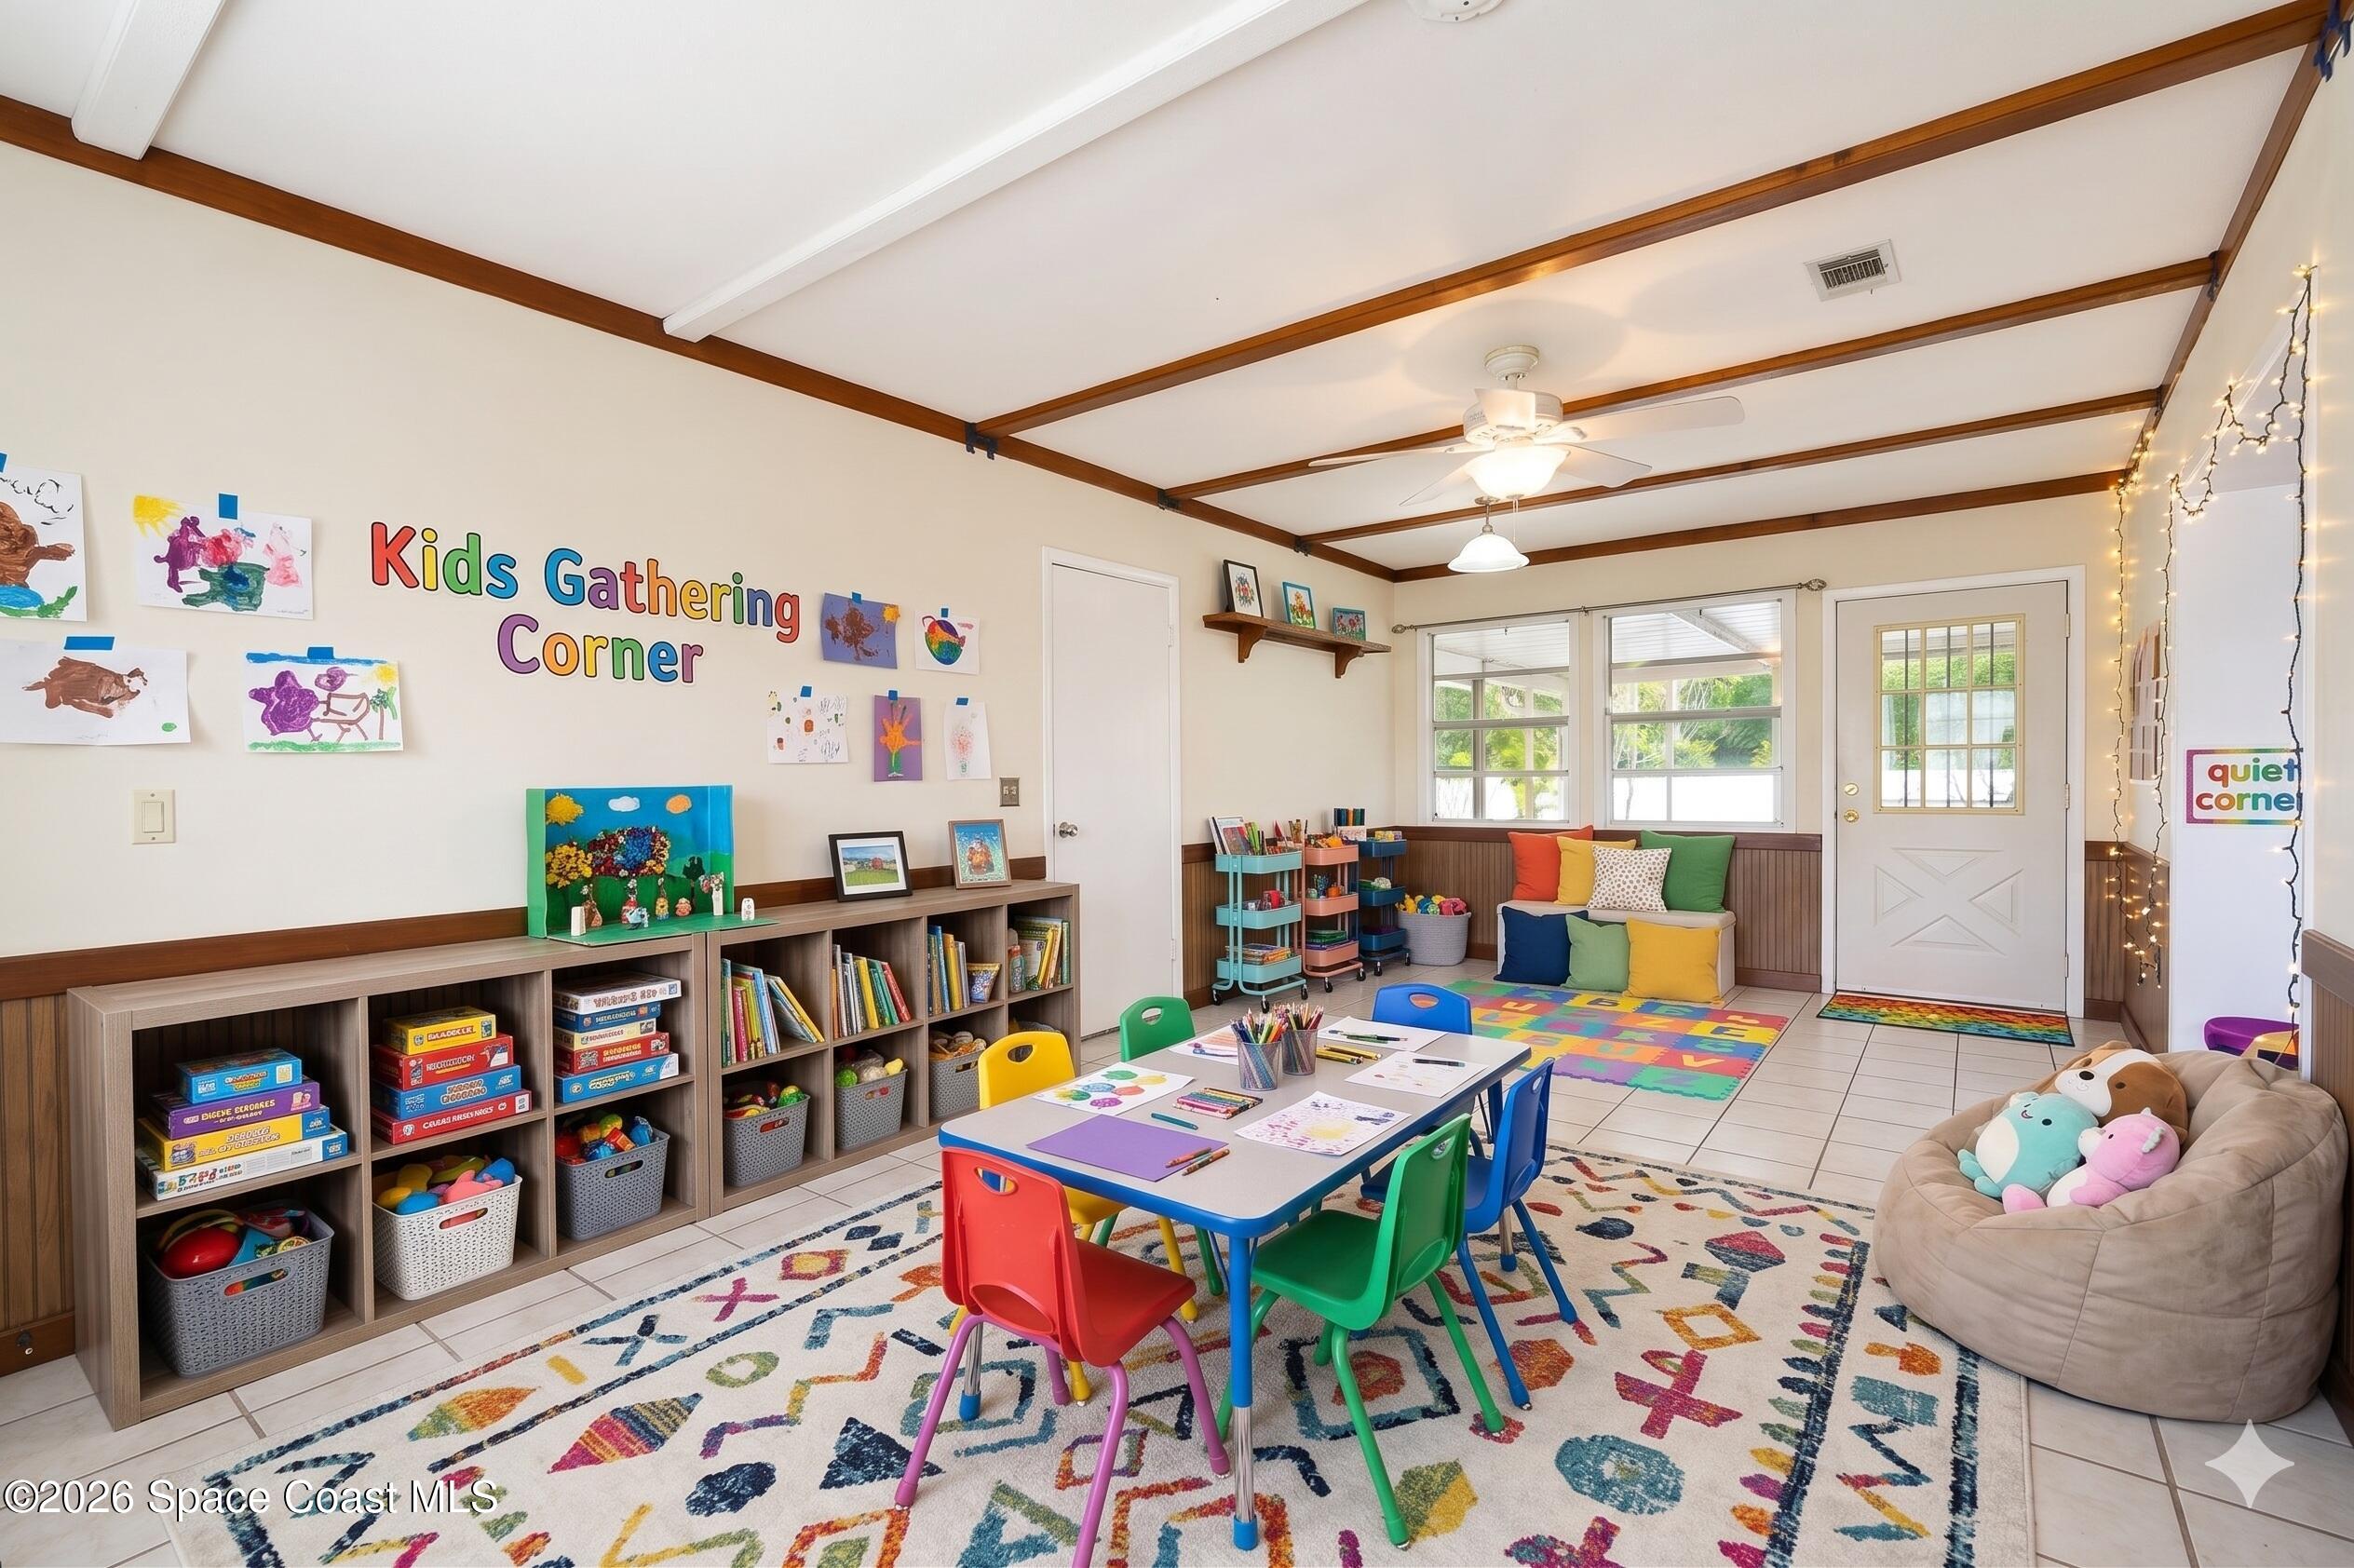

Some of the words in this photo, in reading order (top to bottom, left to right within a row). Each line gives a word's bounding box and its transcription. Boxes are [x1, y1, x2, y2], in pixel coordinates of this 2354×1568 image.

[371, 520, 520, 601] Kids
[544, 547, 801, 644] Gathering
[497, 613, 704, 685] Corner
[2207, 756, 2299, 789] quiet
